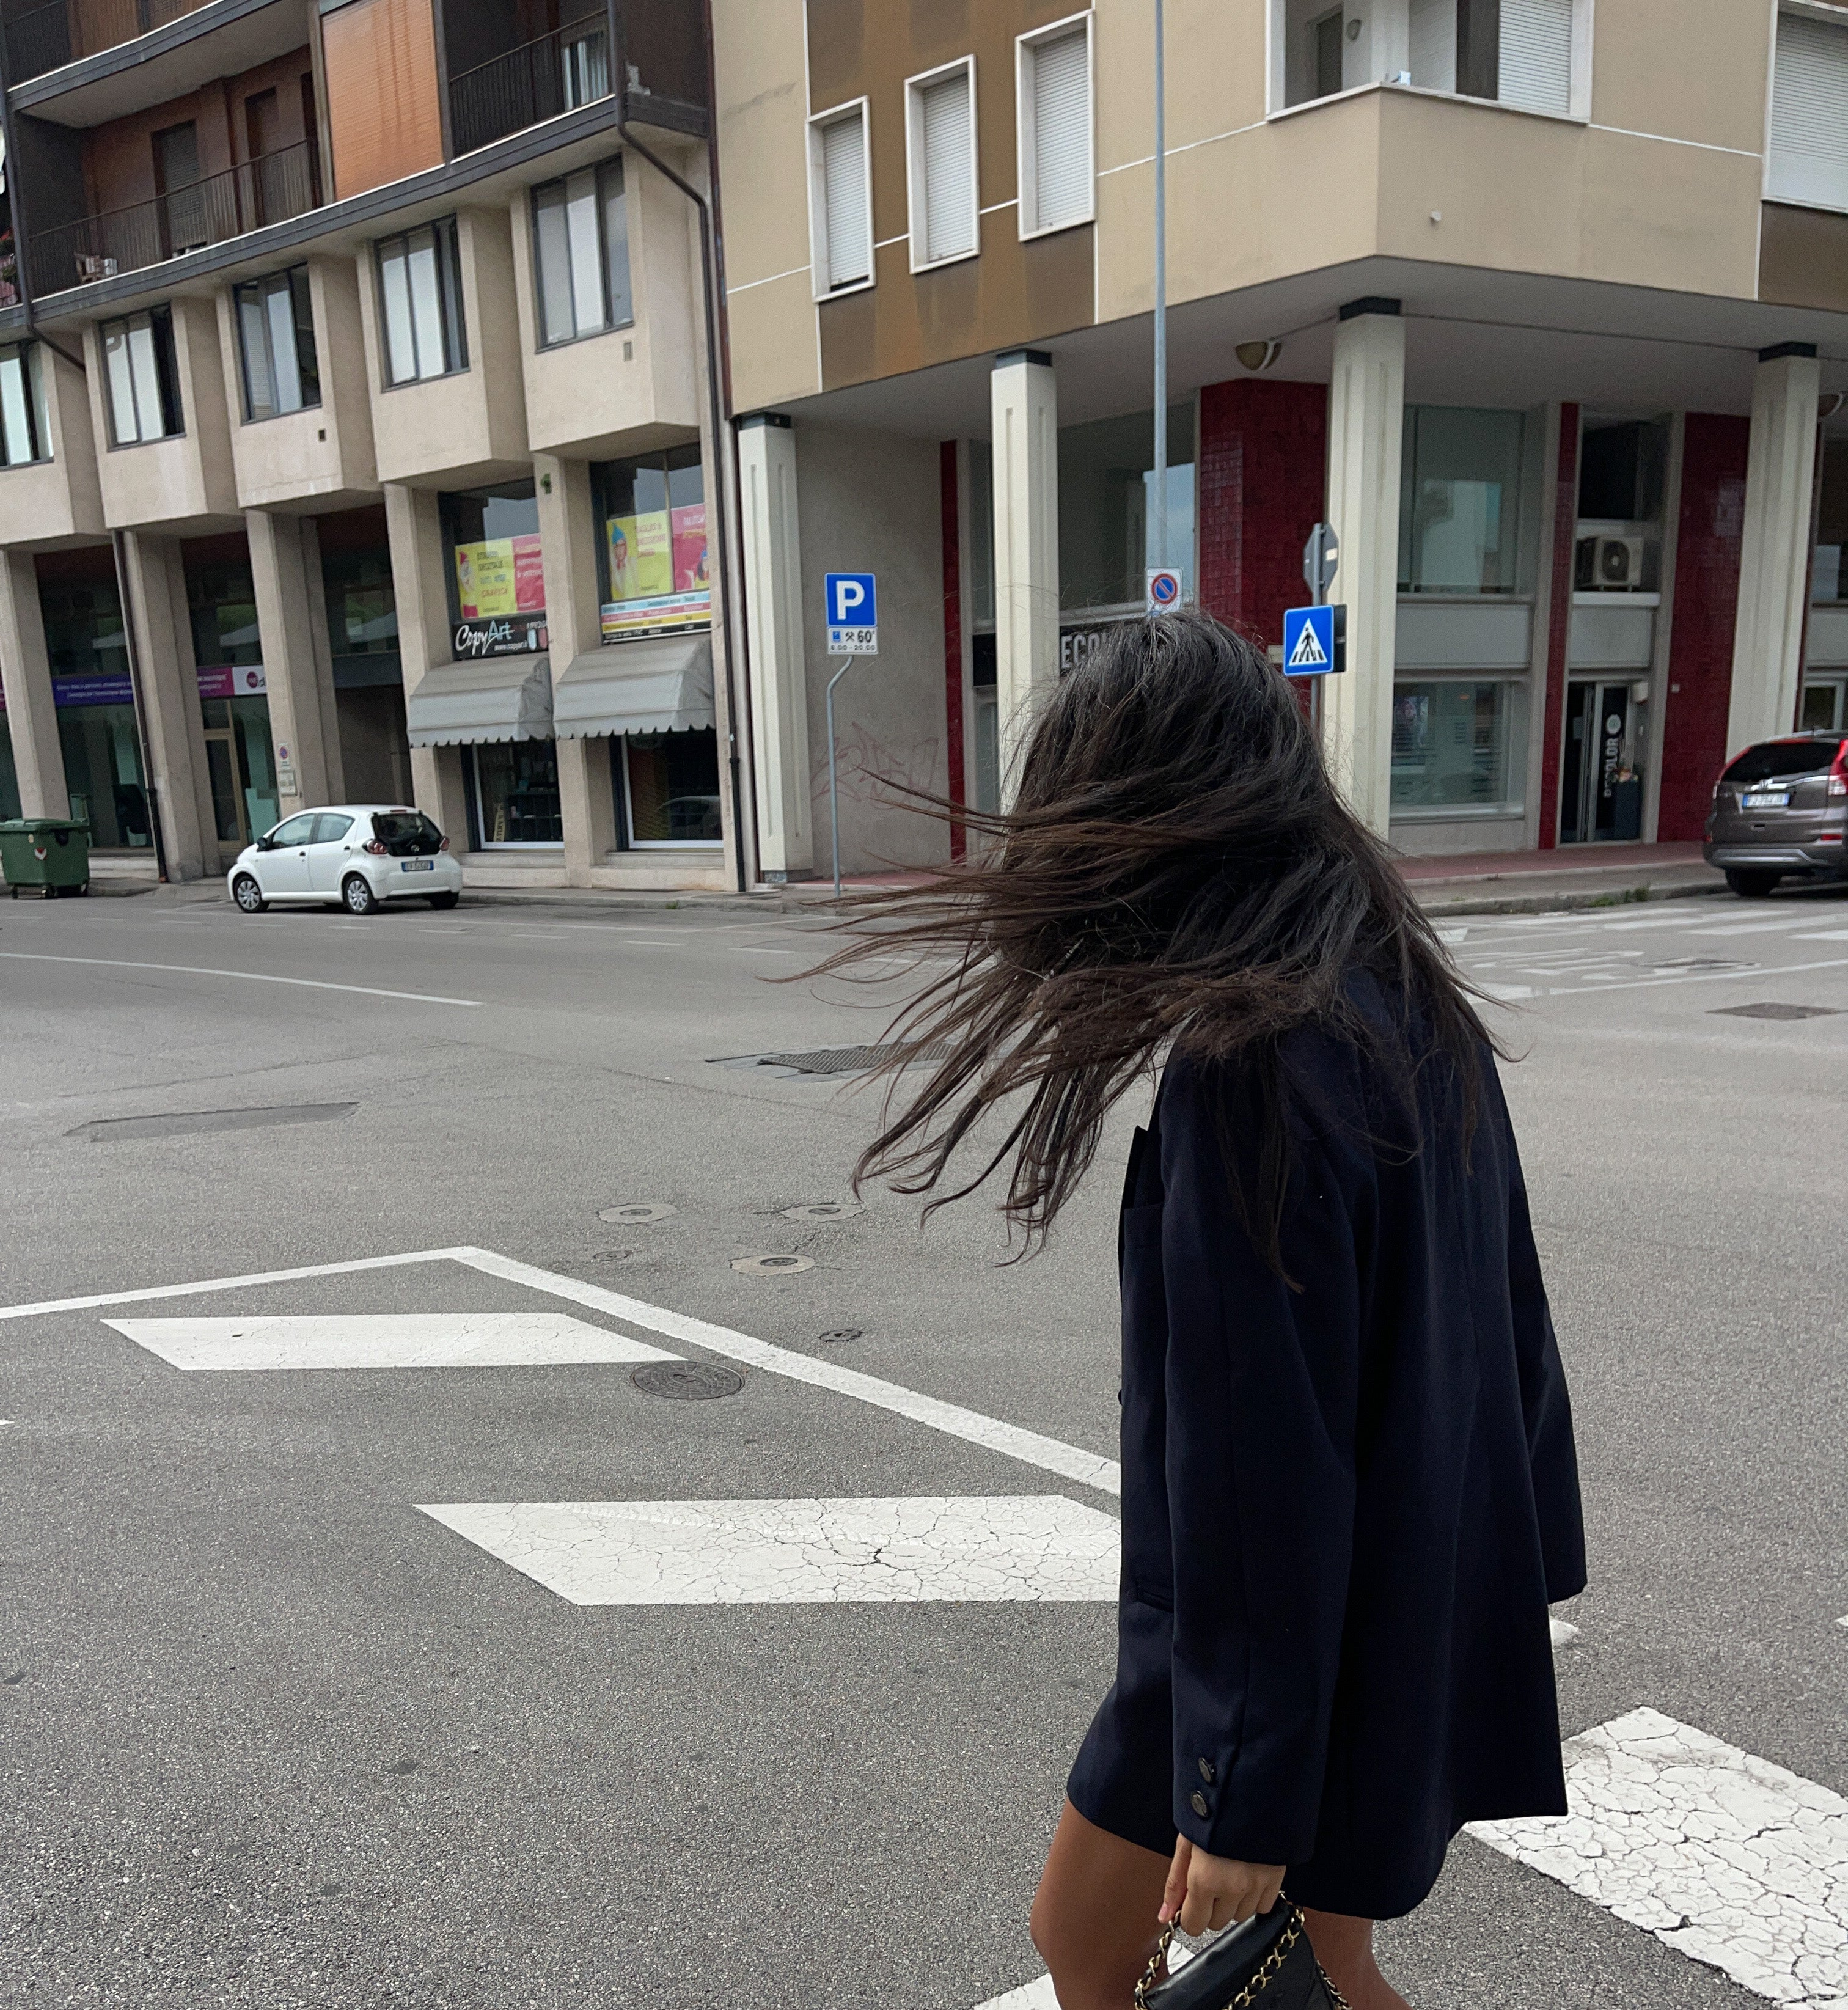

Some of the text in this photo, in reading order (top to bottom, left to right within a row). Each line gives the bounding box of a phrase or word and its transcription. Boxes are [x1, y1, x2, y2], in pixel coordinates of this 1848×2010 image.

[836, 580, 865, 620] P
[455, 620, 515, 656] CopyArt
[1061, 632, 1104, 669] ECO
